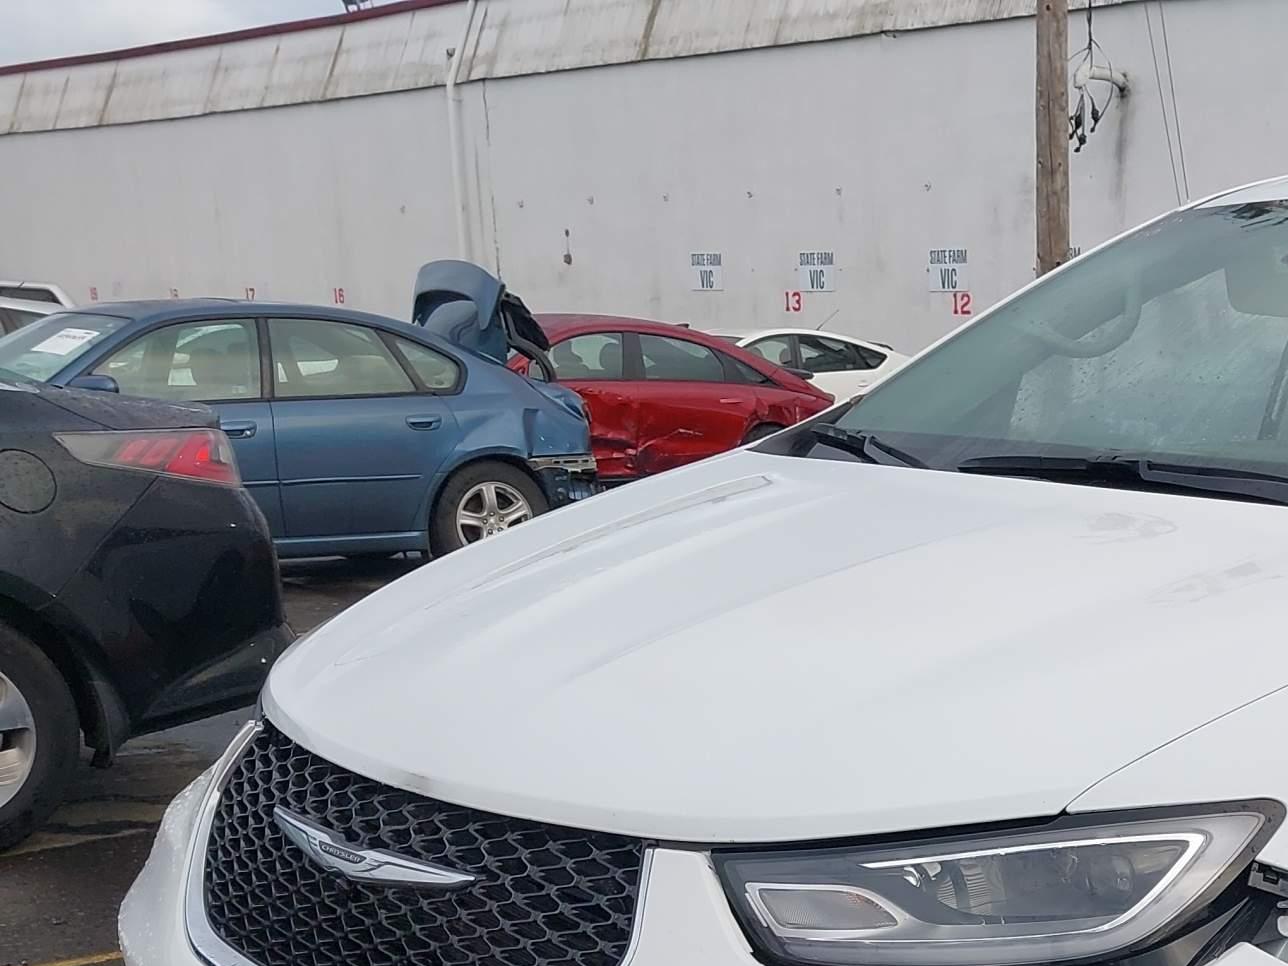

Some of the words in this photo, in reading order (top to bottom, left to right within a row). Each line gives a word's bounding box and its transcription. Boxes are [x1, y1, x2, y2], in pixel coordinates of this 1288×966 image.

[691, 254, 705, 266] STATE
[706, 253, 721, 266] FARM
[800, 253, 816, 266] STATE
[817, 252, 834, 266] FARM
[929, 250, 947, 264] STATE
[948, 249, 967, 264] FARM
[700, 270, 714, 289] VIC
[809, 269, 825, 289] VIC
[940, 267, 957, 289] VIC
[334, 287, 345, 304] 16
[785, 291, 801, 312] 13
[953, 292, 972, 315] 12
